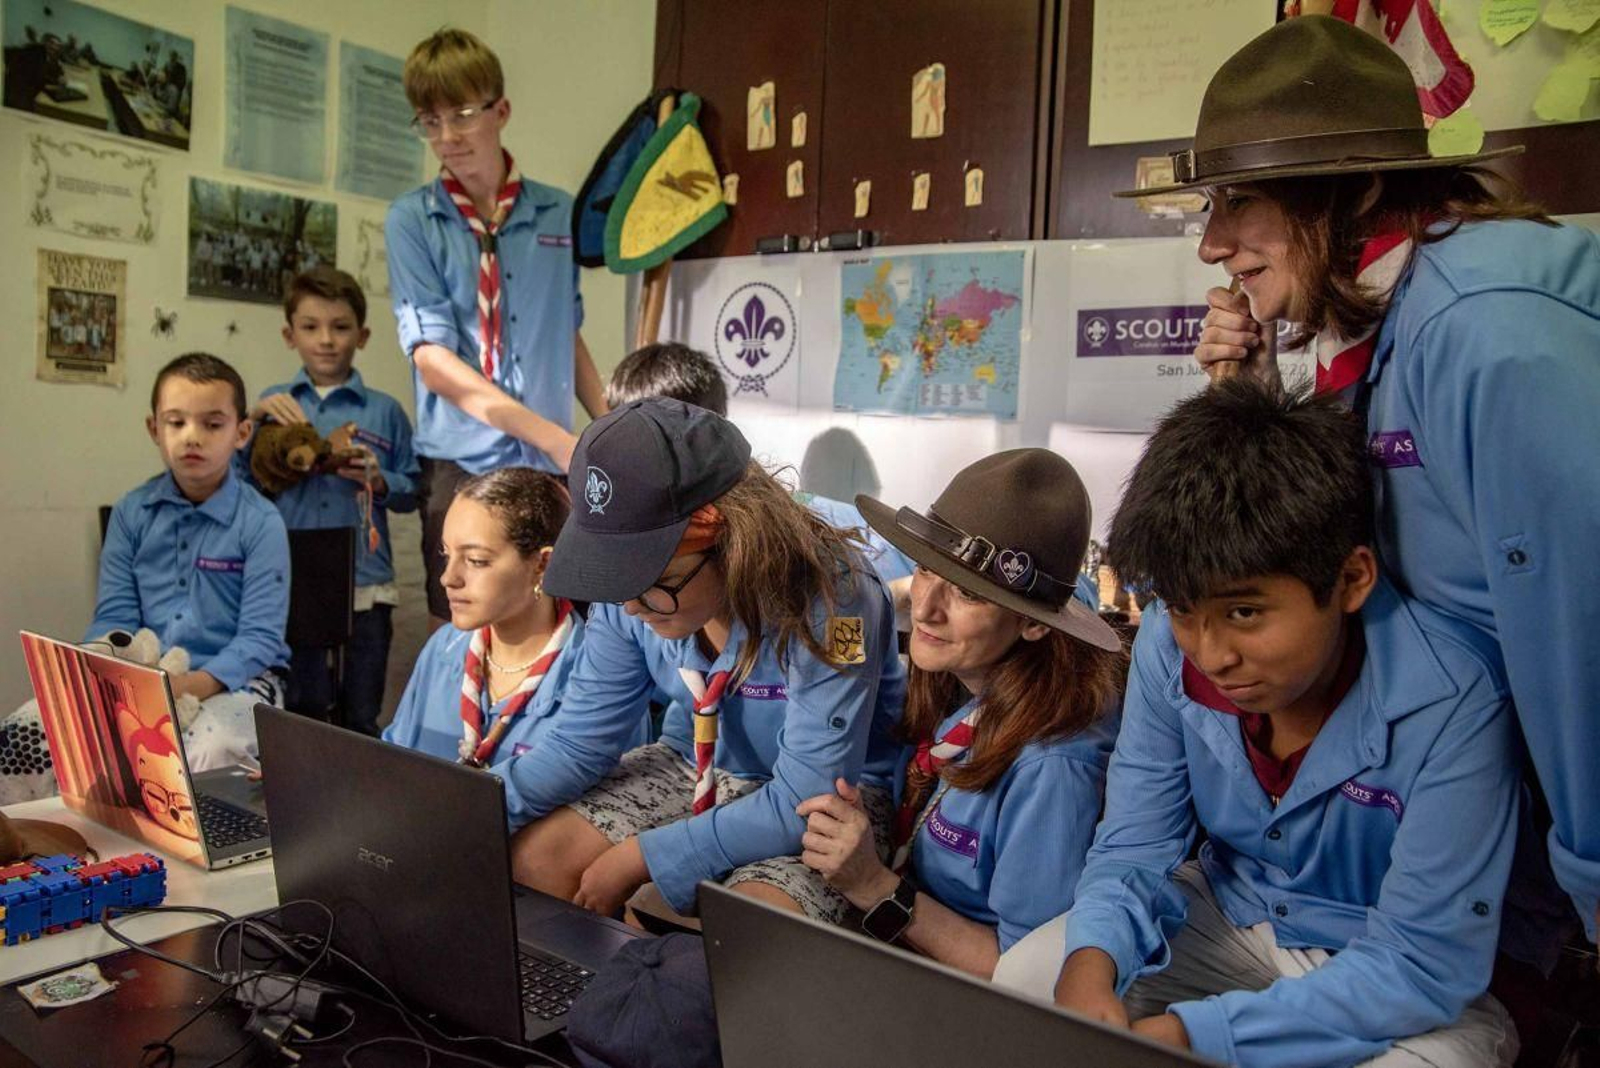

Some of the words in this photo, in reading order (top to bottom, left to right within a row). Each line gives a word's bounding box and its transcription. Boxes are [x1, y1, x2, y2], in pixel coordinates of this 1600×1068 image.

[1157, 364, 1183, 376] San
[1187, 363, 1206, 376] Jua
[1393, 439, 1413, 453] AS
[1344, 782, 1374, 800] OUTS
[968, 838, 977, 848] A
[358, 847, 394, 872] acer
